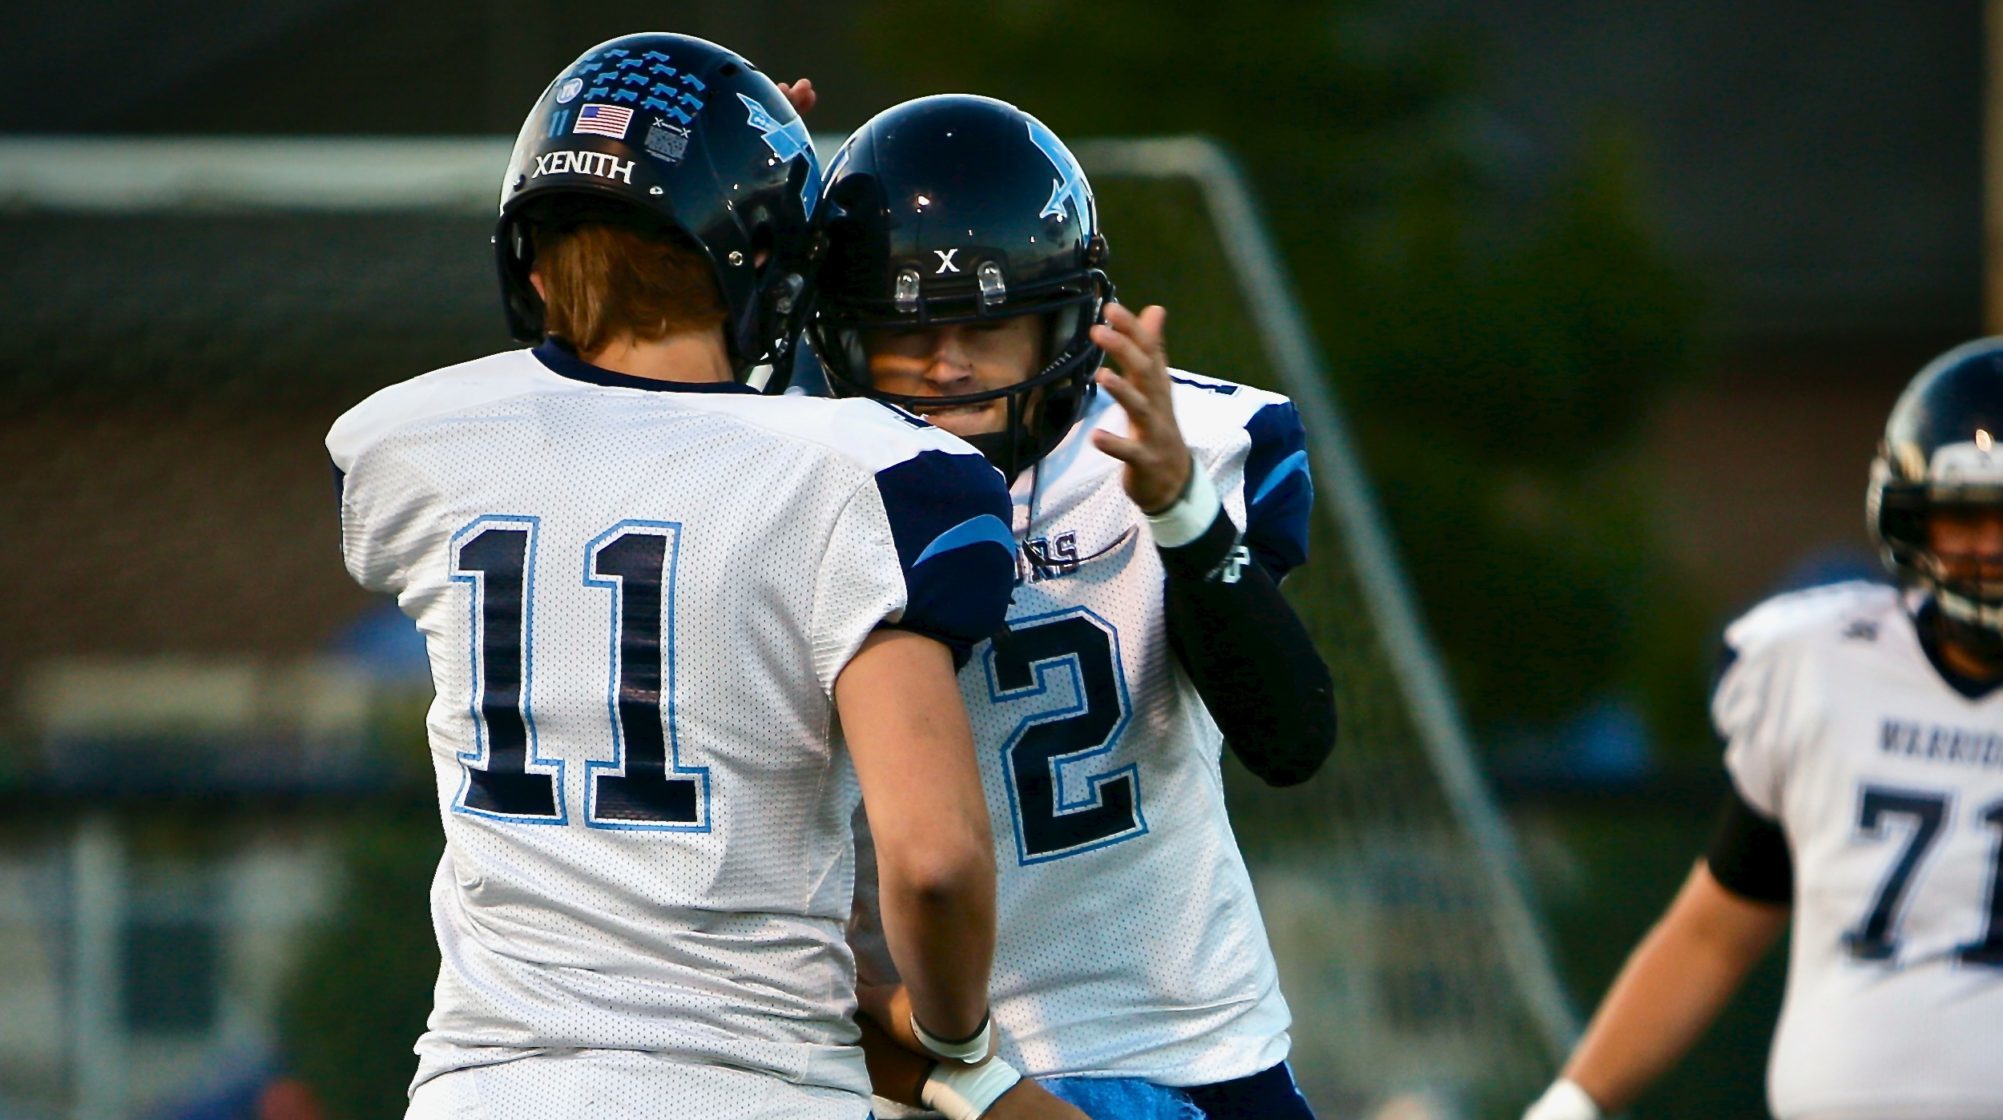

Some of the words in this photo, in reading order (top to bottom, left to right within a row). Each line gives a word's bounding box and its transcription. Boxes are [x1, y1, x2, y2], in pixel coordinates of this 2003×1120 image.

[548, 109, 570, 138] 11
[532, 150, 636, 185] XENITH
[934, 249, 960, 273] X
[450, 514, 712, 833] 11
[981, 605, 1149, 867] 2
